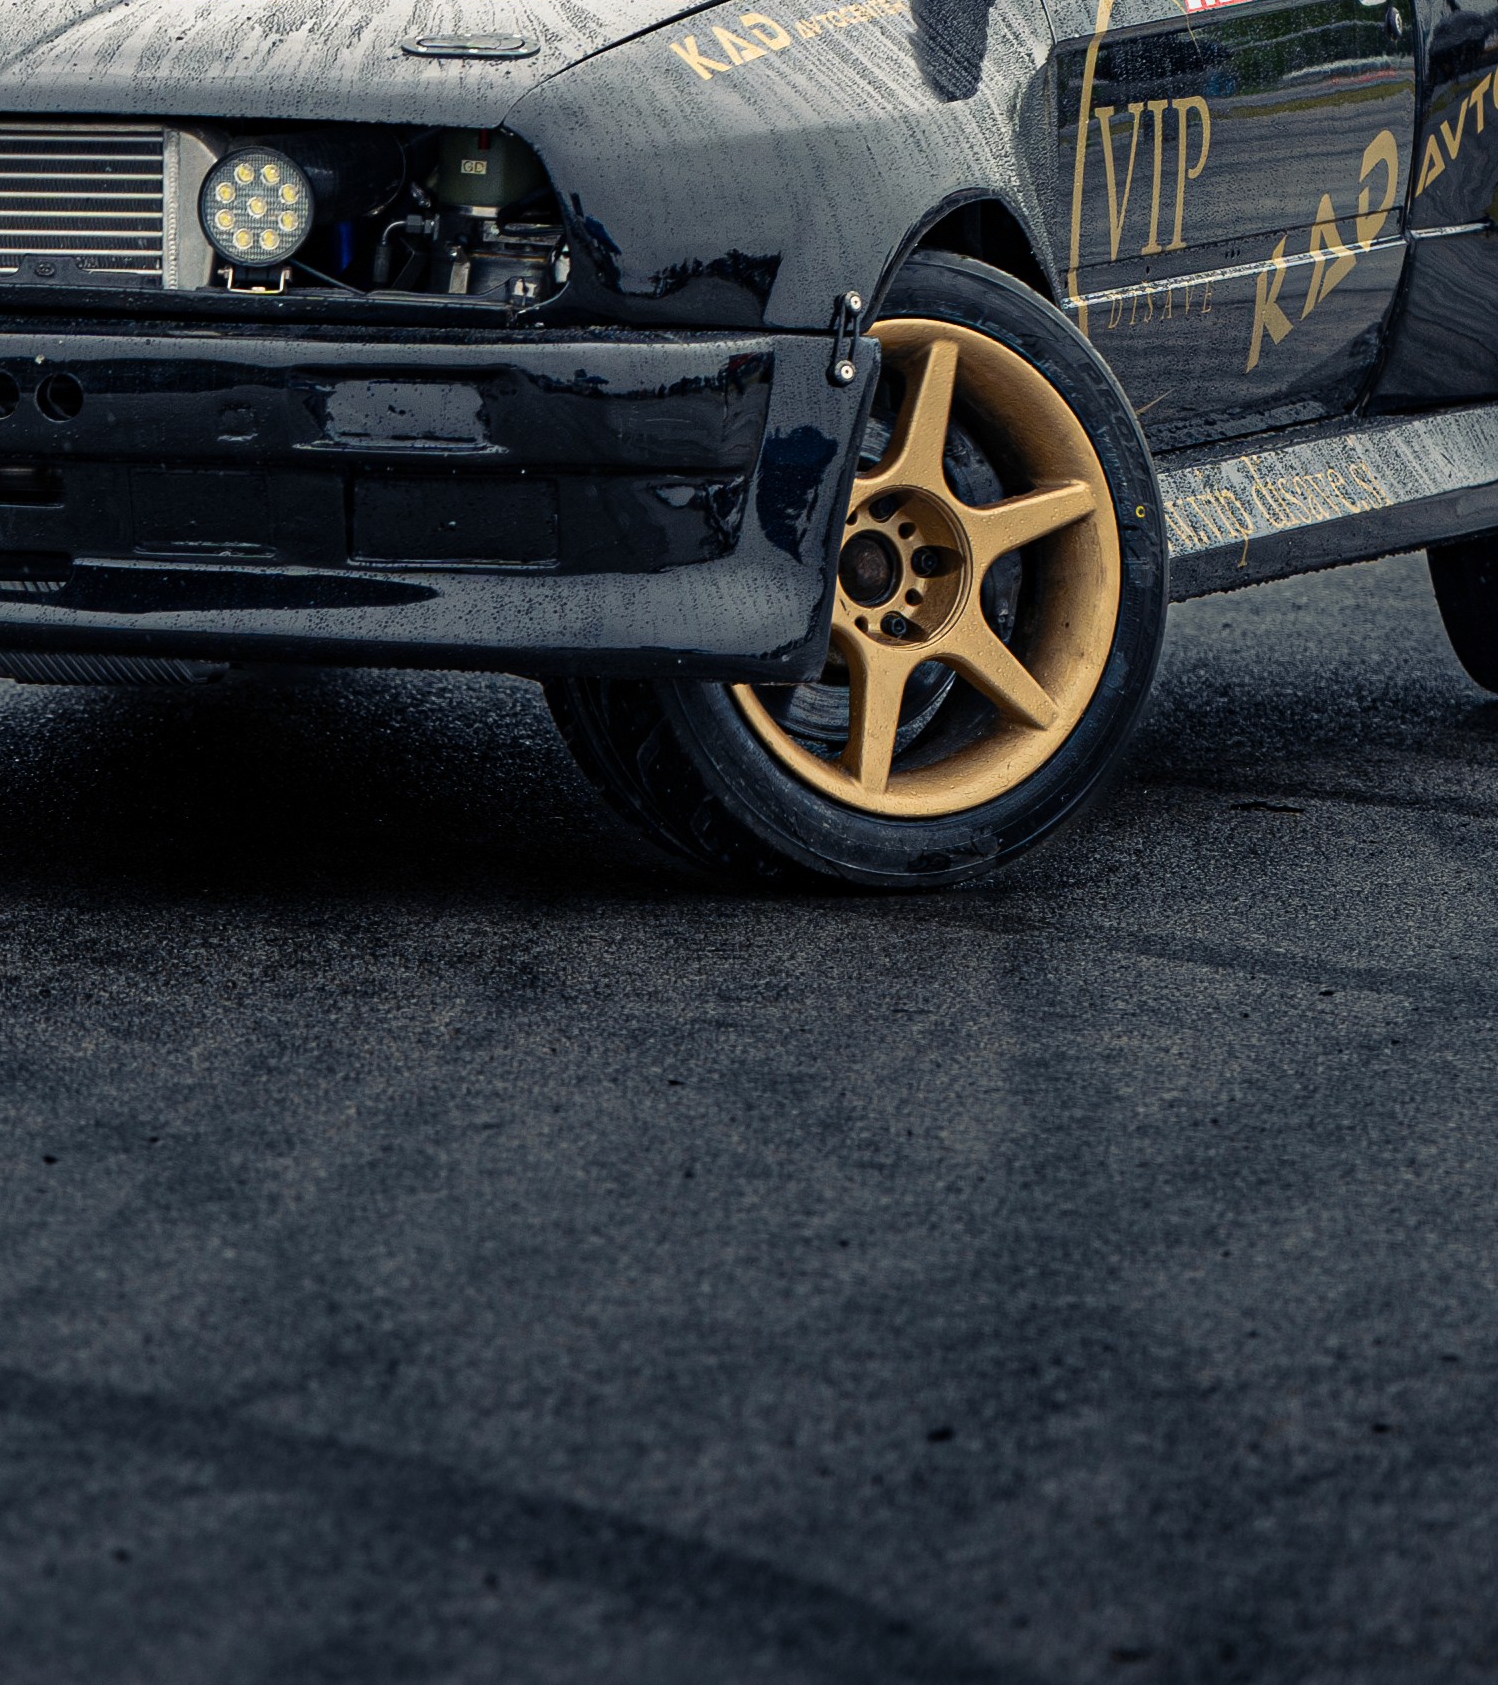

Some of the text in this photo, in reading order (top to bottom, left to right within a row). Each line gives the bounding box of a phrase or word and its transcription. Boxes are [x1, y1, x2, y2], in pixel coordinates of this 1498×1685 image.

[669, 12, 791, 80] KAD
[1095, 95, 1211, 261] VIP
[1246, 129, 1399, 374] KAD
